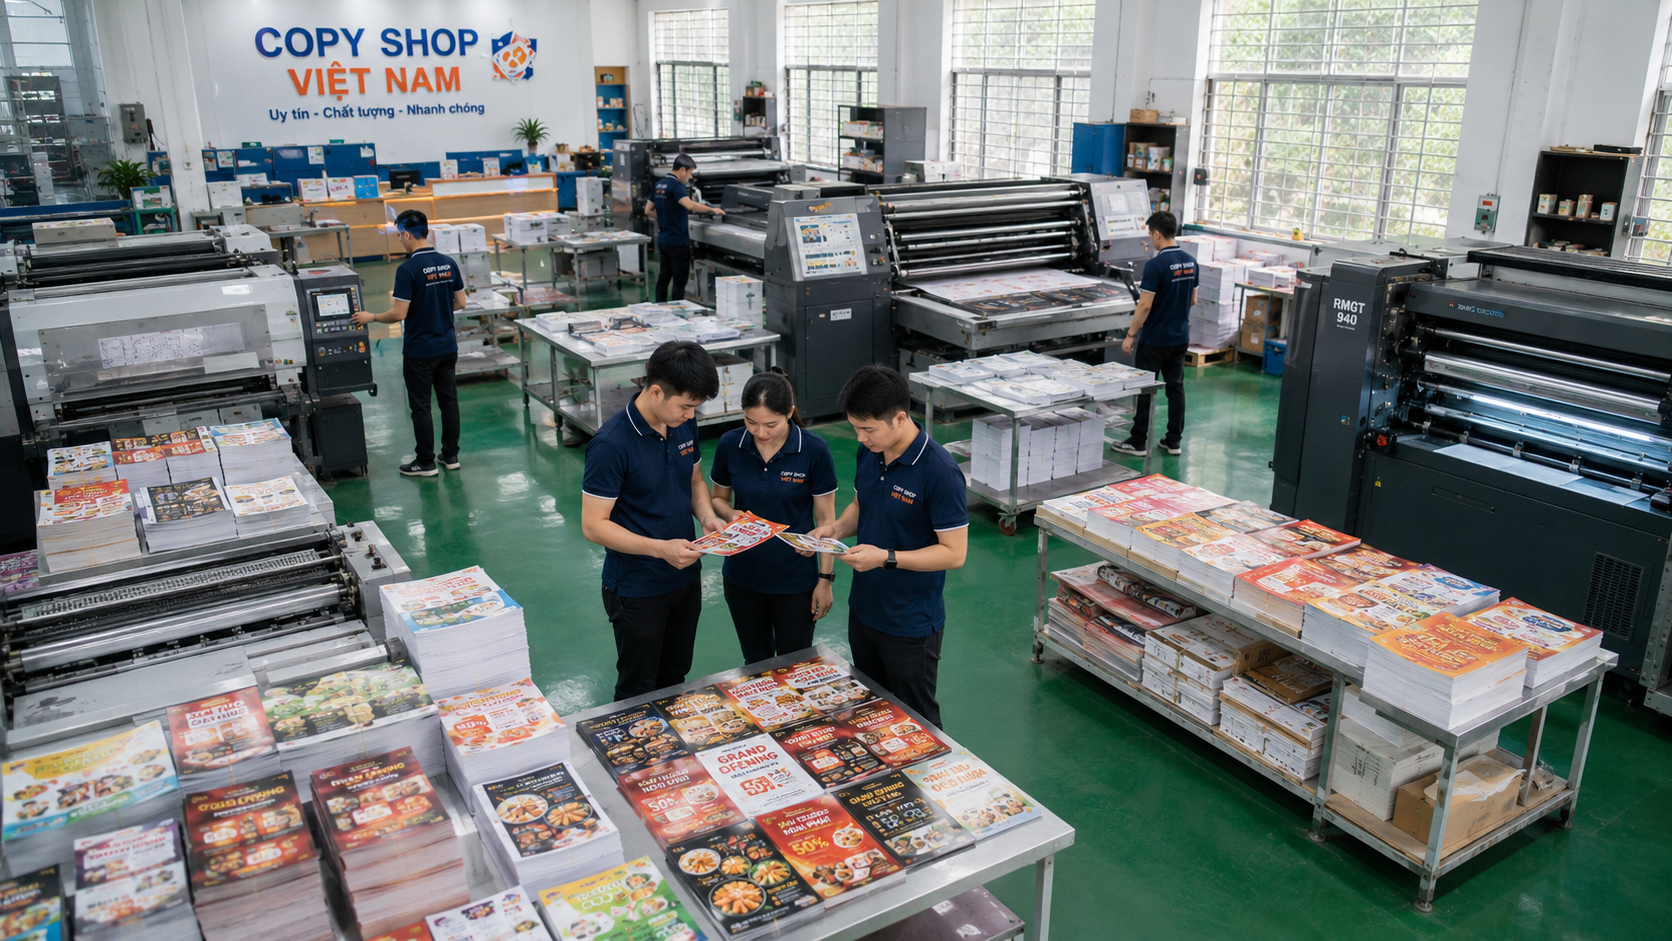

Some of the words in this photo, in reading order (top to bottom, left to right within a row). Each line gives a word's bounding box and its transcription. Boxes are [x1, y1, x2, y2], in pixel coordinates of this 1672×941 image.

[254, 26, 366, 58] COPY
[380, 27, 479, 58] SHOP
[287, 61, 371, 101] VIỆT
[385, 66, 462, 94] NAM
[269, 108, 287, 123] Uy
[291, 107, 310, 120] tín
[323, 104, 354, 119] Chất
[407, 103, 445, 116] Nhanh
[448, 102, 485, 116] chóng
[1333, 297, 1366, 314] RMGT
[1336, 311, 1358, 326] 940
[717, 744, 767, 764] GRAND
[792, 836, 830, 856] 50%
